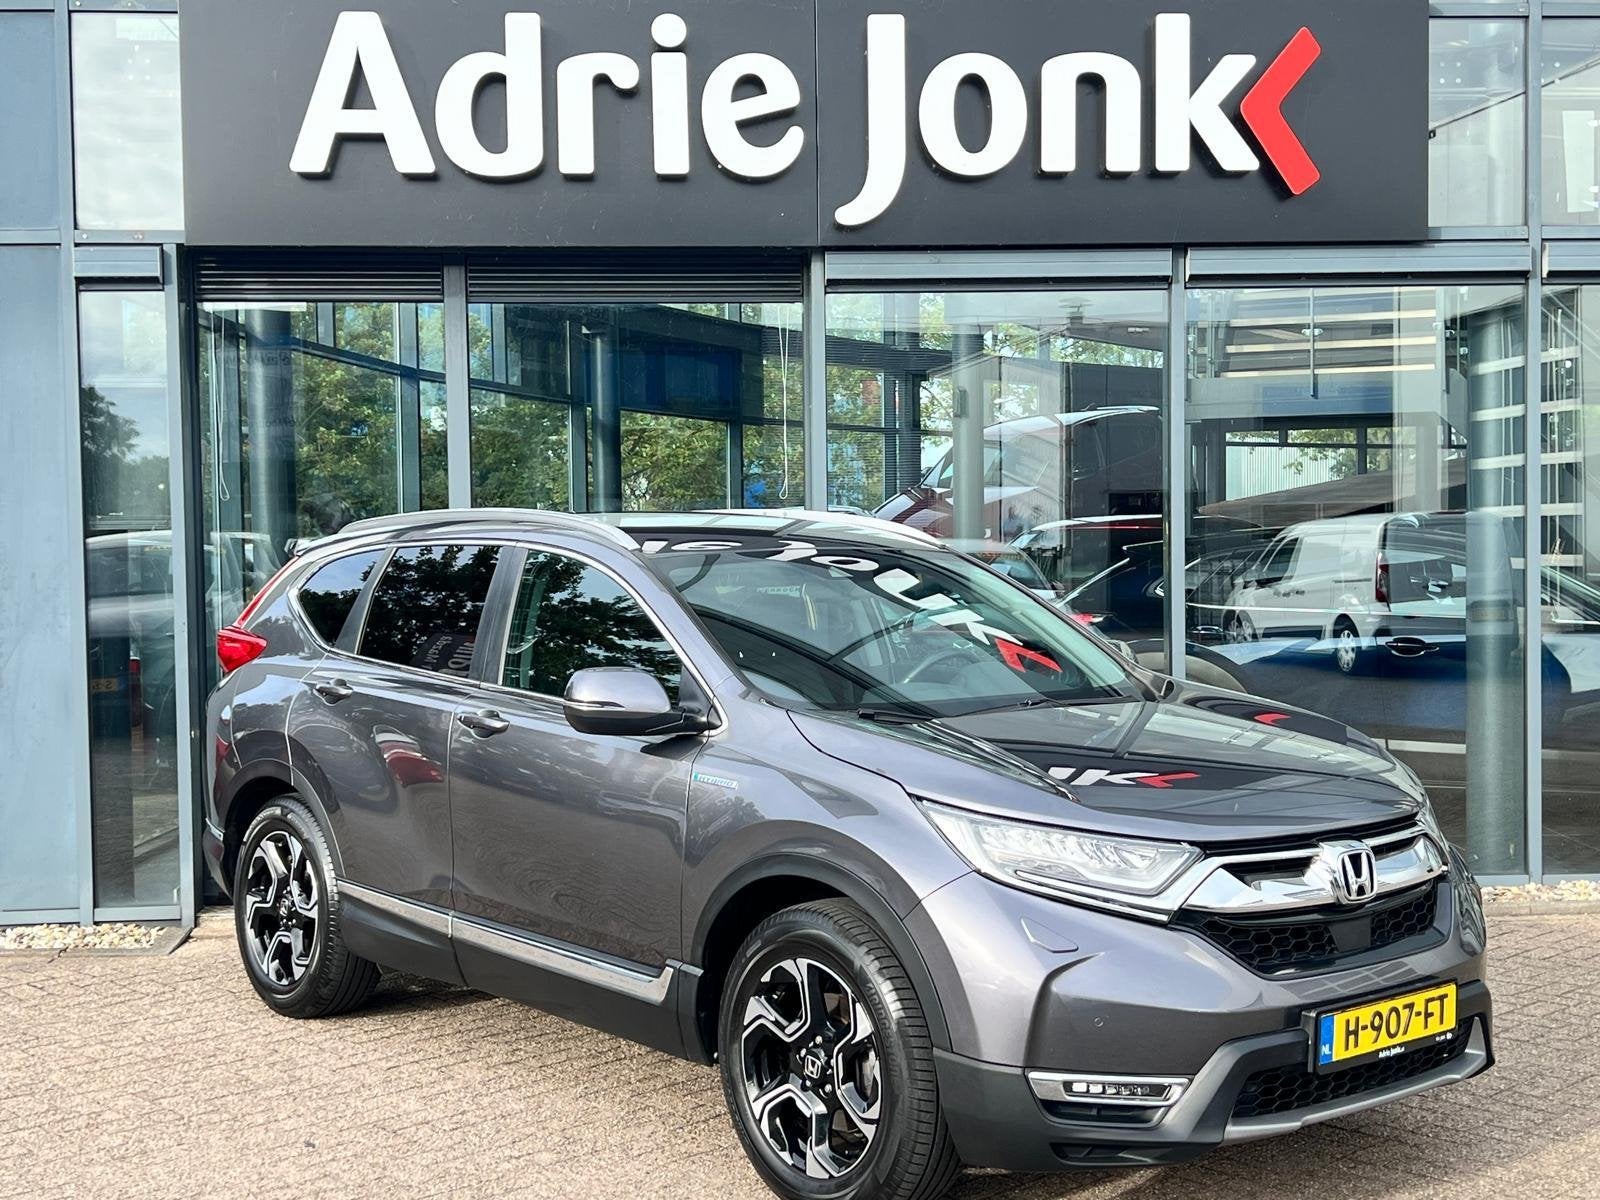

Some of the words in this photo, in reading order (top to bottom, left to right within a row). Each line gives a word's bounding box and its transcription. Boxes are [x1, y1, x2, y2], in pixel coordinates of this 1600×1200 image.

[289, 11, 805, 179] Adrie
[834, 13, 1261, 227] Jonk
[1321, 1043, 1332, 1056] NL
[1344, 993, 1449, 1051] H-907-FT
